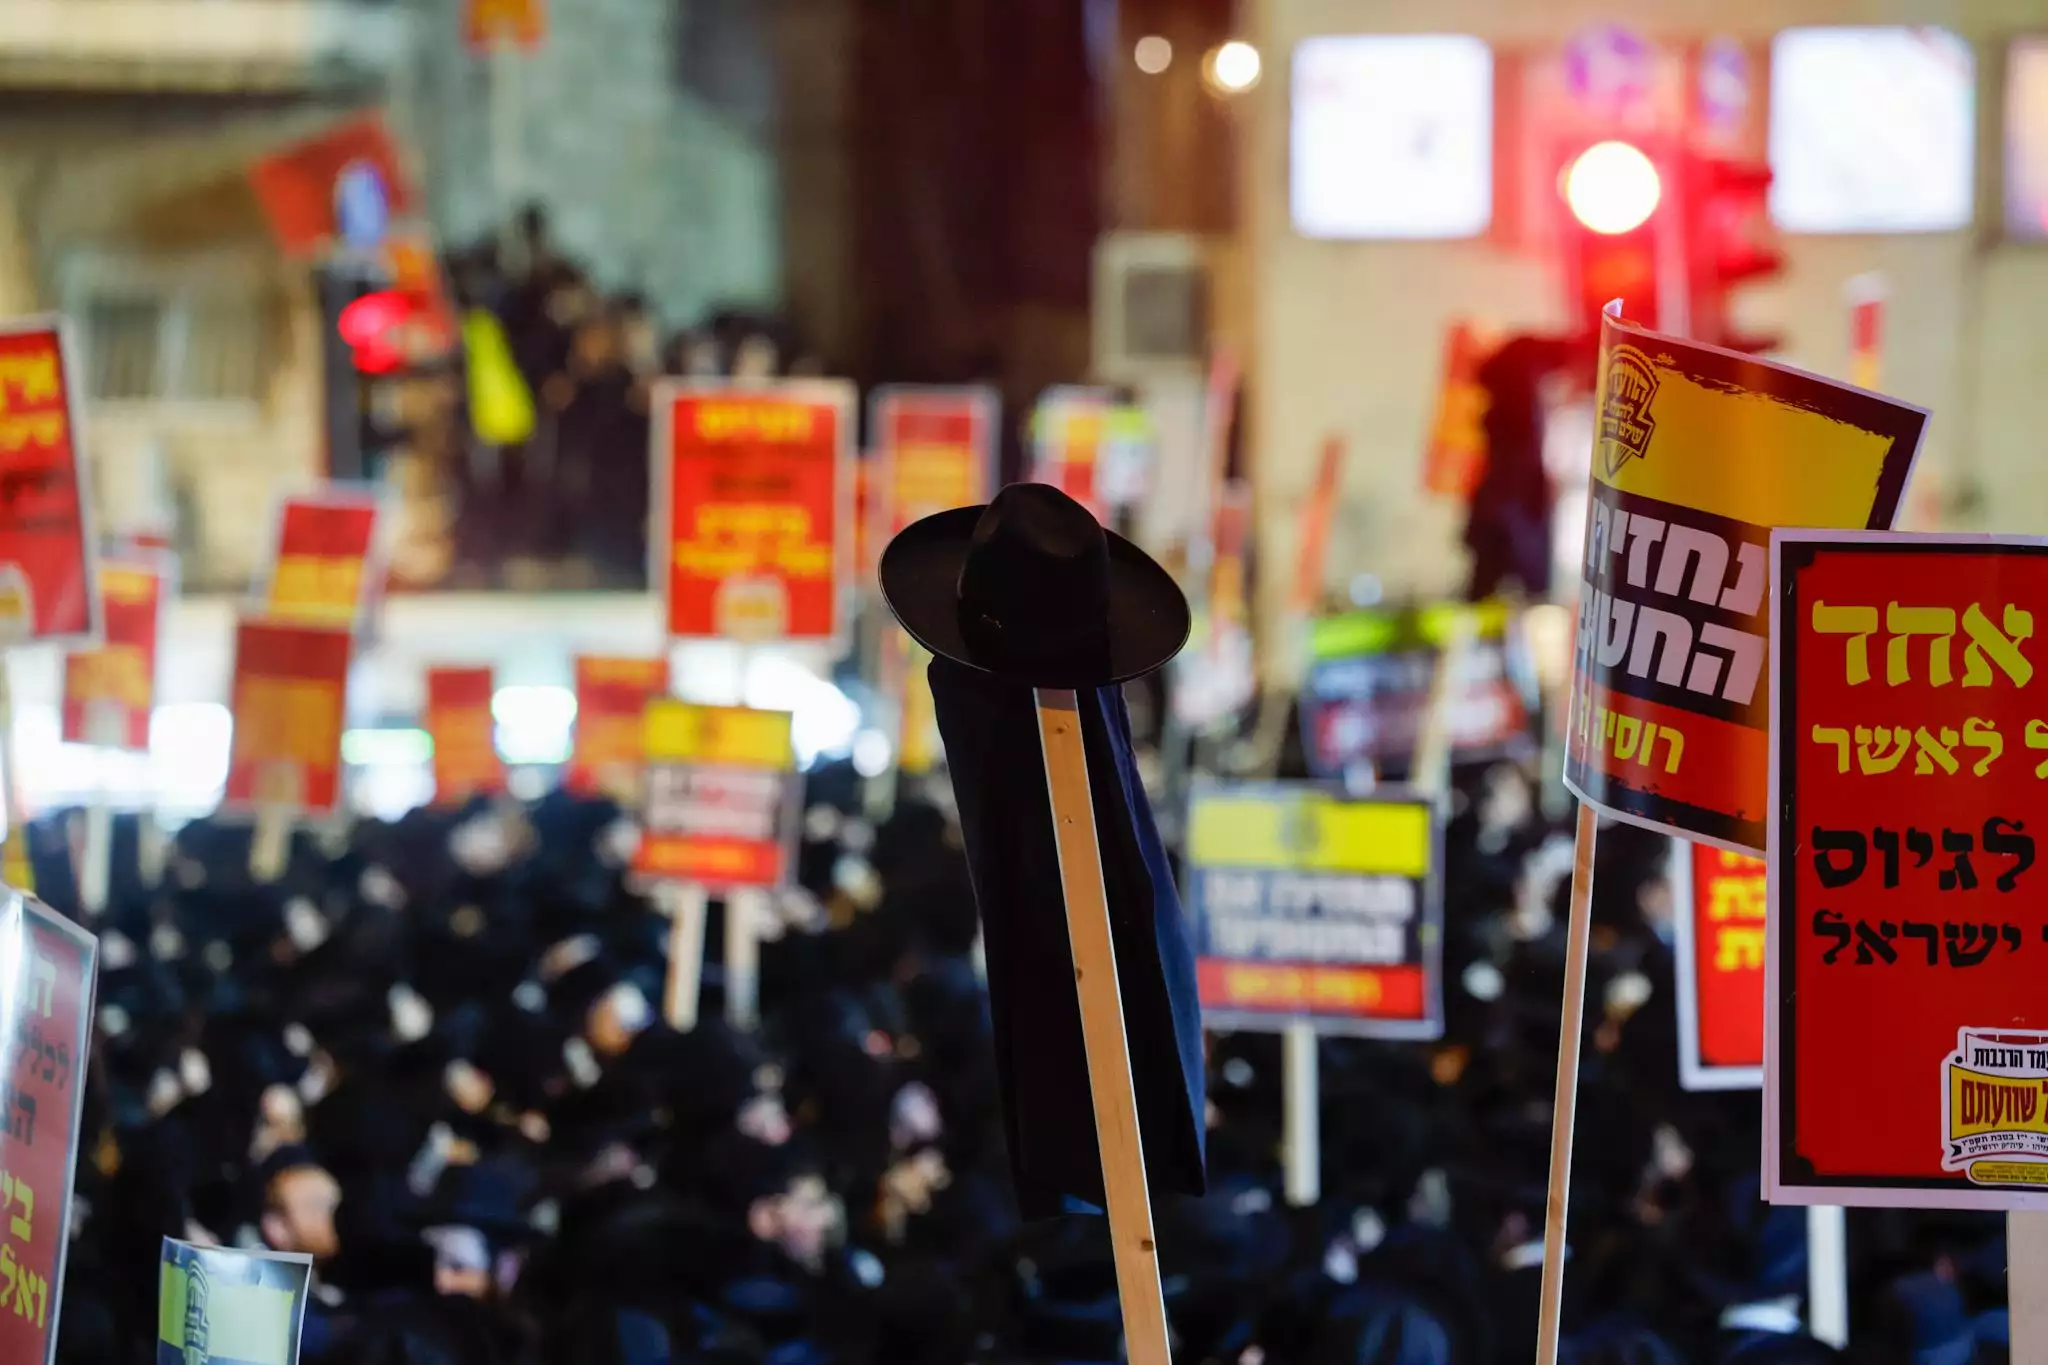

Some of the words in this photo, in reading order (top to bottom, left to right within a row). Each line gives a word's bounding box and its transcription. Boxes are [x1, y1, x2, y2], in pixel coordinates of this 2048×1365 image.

[1812, 600, 2034, 688] אחד
[1812, 717, 2004, 777] לאשר
[1812, 817, 2036, 893] לגיוס
[1813, 909, 2021, 968] ישראל
[1974, 1047, 2024, 1068] הרבבות
[1961, 1078, 2037, 1128] שוועתם
